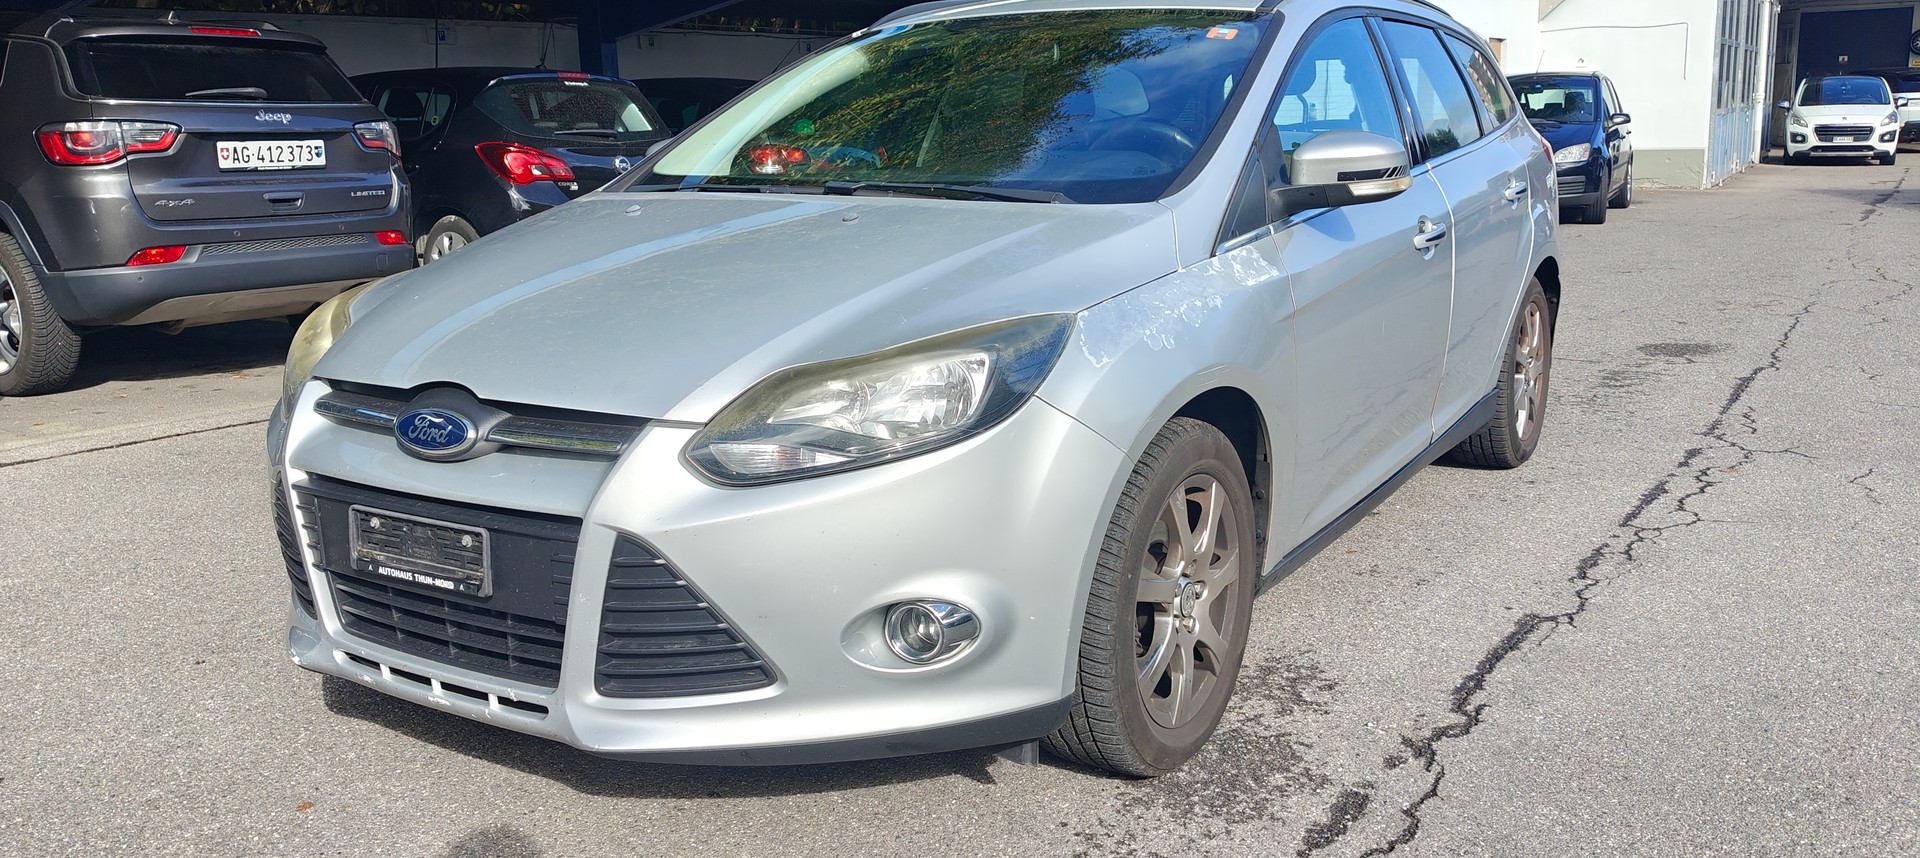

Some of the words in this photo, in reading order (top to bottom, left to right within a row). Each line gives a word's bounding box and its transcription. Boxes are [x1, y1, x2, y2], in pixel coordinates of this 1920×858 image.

[255, 109, 292, 125] Jeep
[408, 414, 453, 443] Ford
[378, 566, 413, 581] AUTOHAUS
[414, 573, 455, 590] THUN-NORD
